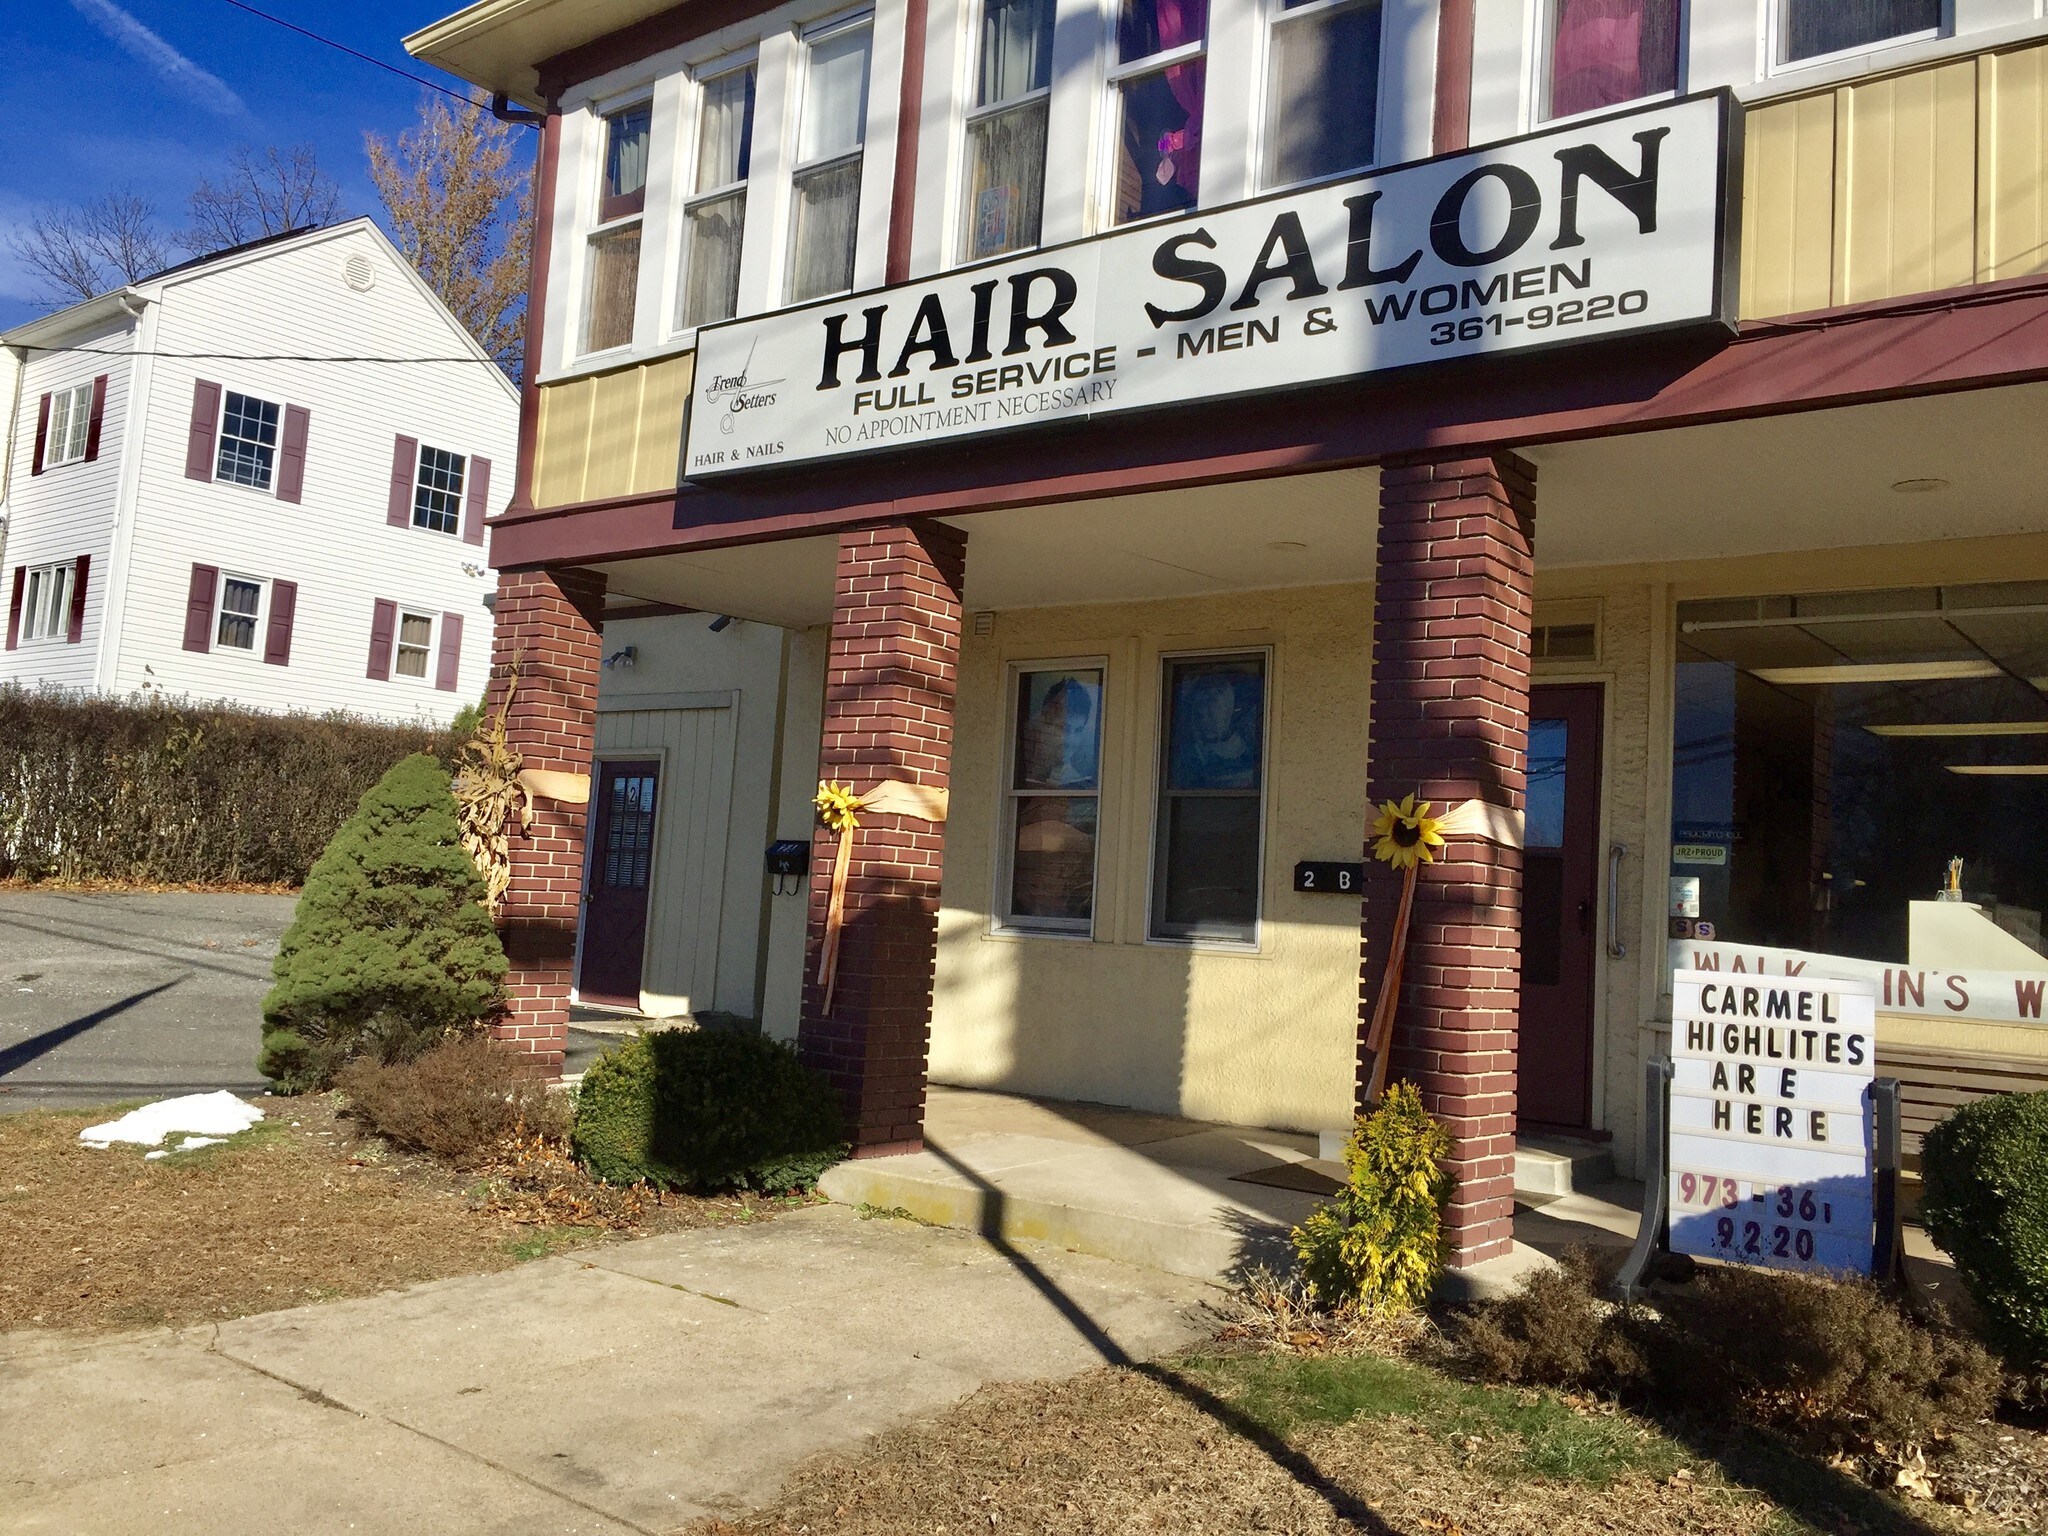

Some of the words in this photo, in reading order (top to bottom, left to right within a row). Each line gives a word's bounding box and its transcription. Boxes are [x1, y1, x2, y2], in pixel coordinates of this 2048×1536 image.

[816, 267, 1078, 391] HAIR
[1144, 126, 1671, 329] SALON
[853, 382, 935, 415] FULL
[951, 346, 1118, 399] SERVICE
[1136, 346, 1157, 358] -
[1176, 316, 1280, 359] MEN
[1303, 306, 1338, 336] &
[1364, 258, 1592, 325] WOMEN
[1430, 289, 1649, 345] 361-9220
[706, 369, 747, 393] Trend
[730, 393, 777, 413] Setters
[825, 425, 851, 446] NO
[857, 402, 992, 442] APPOINTMENT
[997, 379, 1118, 419] NECESSARY
[694, 451, 725, 467] HAIR
[730, 449, 740, 461] &
[746, 441, 784, 458] NAILS
[1303, 871, 1315, 887] 2
[1339, 871, 1351, 889] B
[1701, 984, 1837, 1023] CARMEL
[1688, 1020, 1865, 1065] HIGHLITES
[1714, 1100, 1827, 1141] HERE
[1717, 1217, 1814, 1261] 9220
